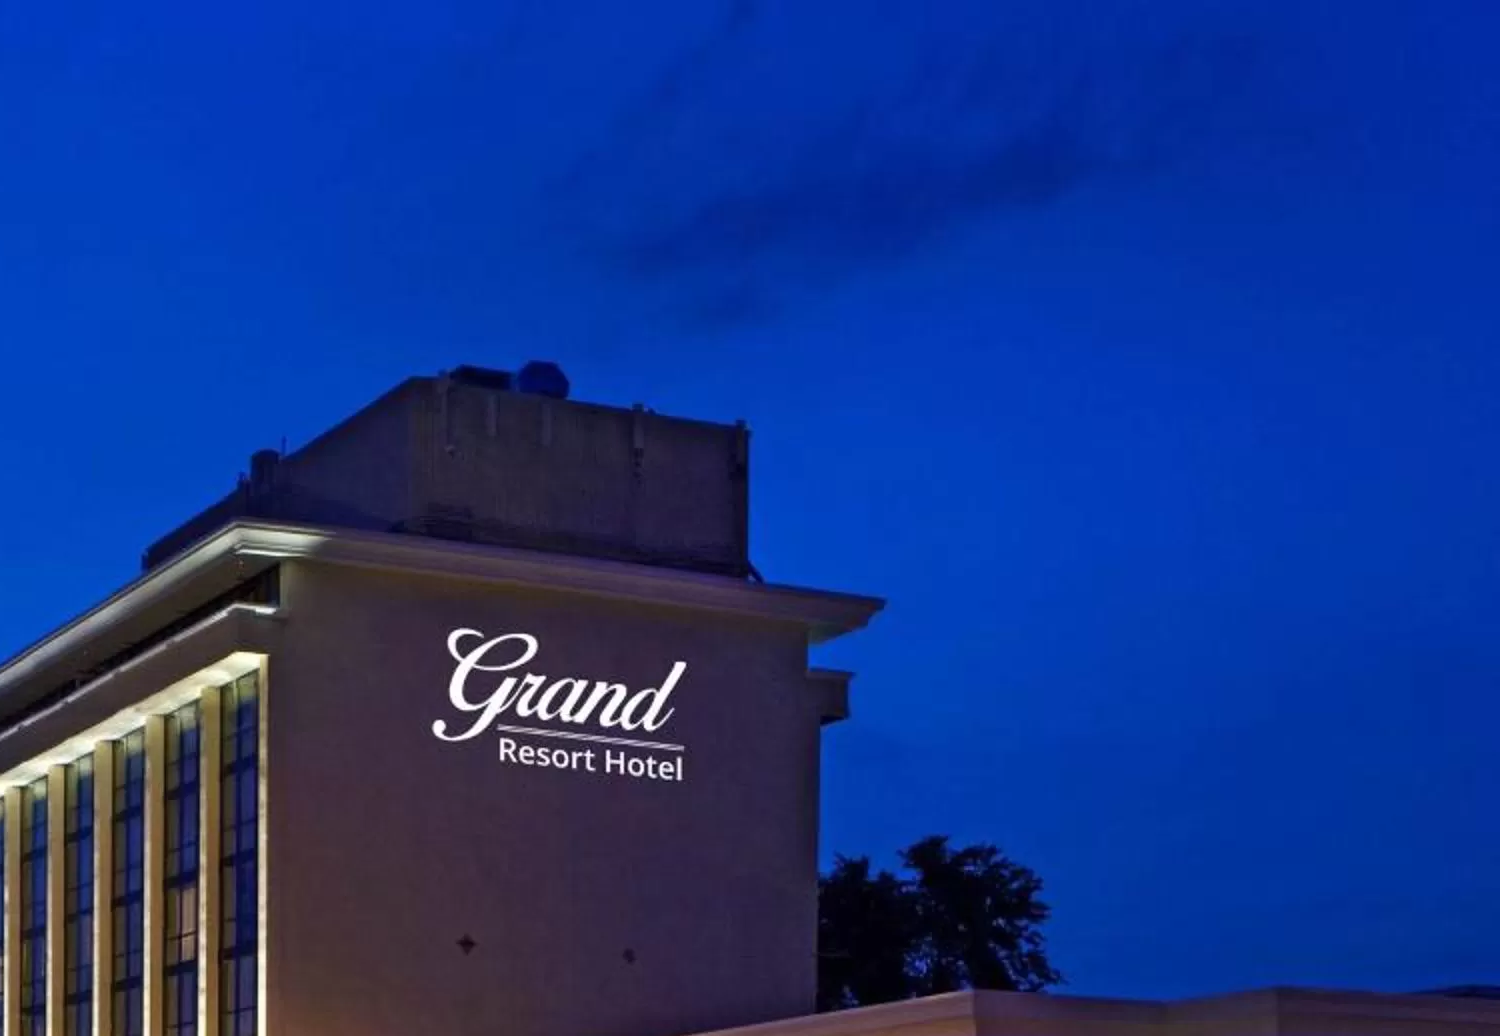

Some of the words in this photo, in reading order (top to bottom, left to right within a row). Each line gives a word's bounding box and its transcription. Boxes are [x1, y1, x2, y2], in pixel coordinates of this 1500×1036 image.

[431, 627, 687, 742] Grand
[499, 737, 596, 772] Resort
[605, 749, 684, 781] Hotel
